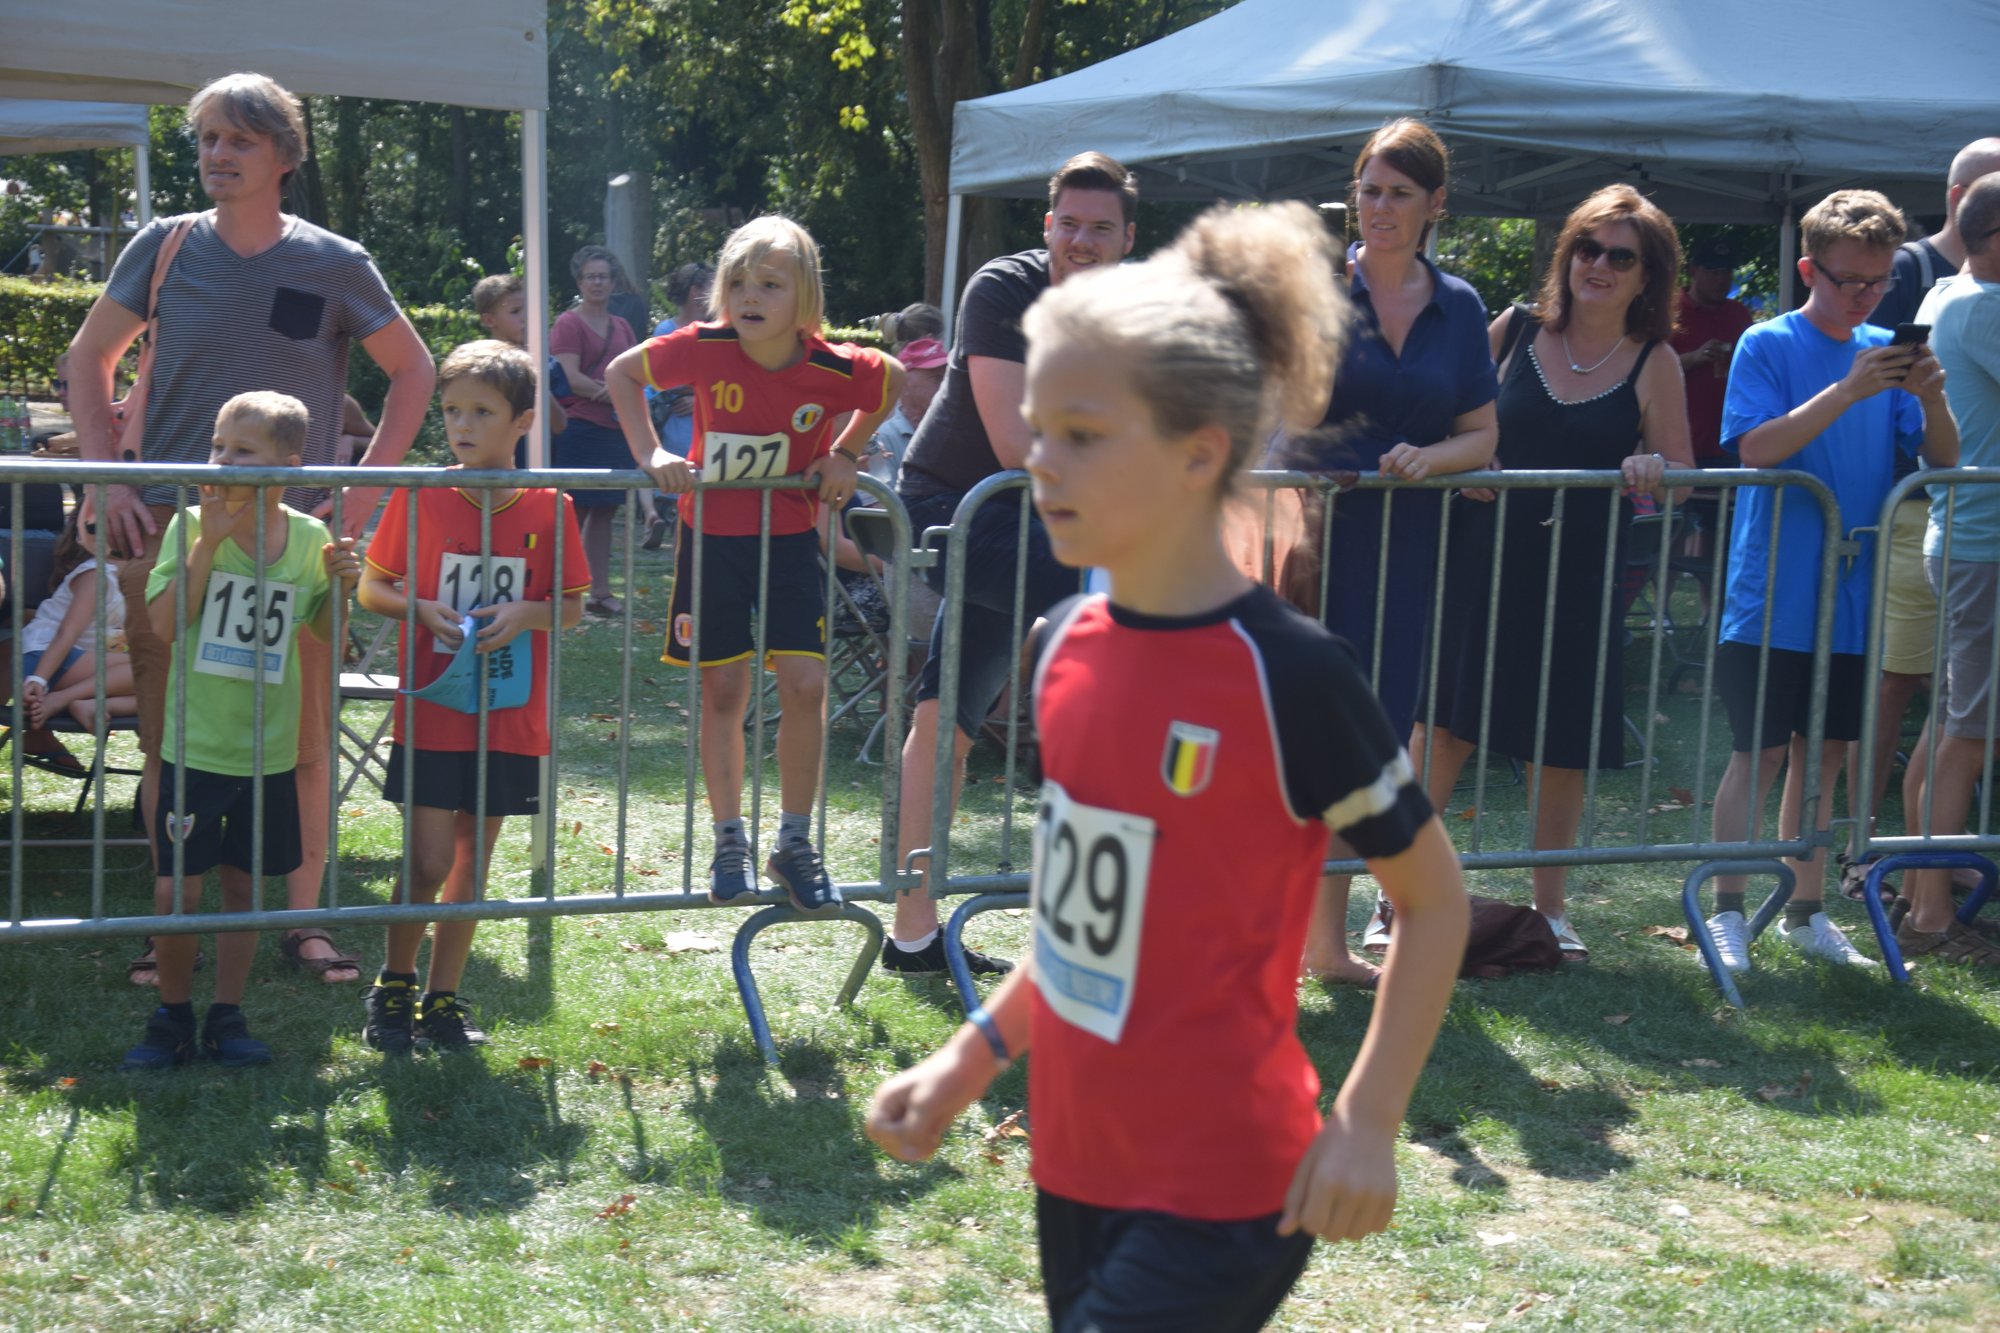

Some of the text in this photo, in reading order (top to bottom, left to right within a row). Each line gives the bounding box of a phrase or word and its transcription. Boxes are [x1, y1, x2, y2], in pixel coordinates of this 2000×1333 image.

[710, 380, 744, 413] 10
[711, 441, 782, 480] 127
[214, 580, 288, 646] 135
